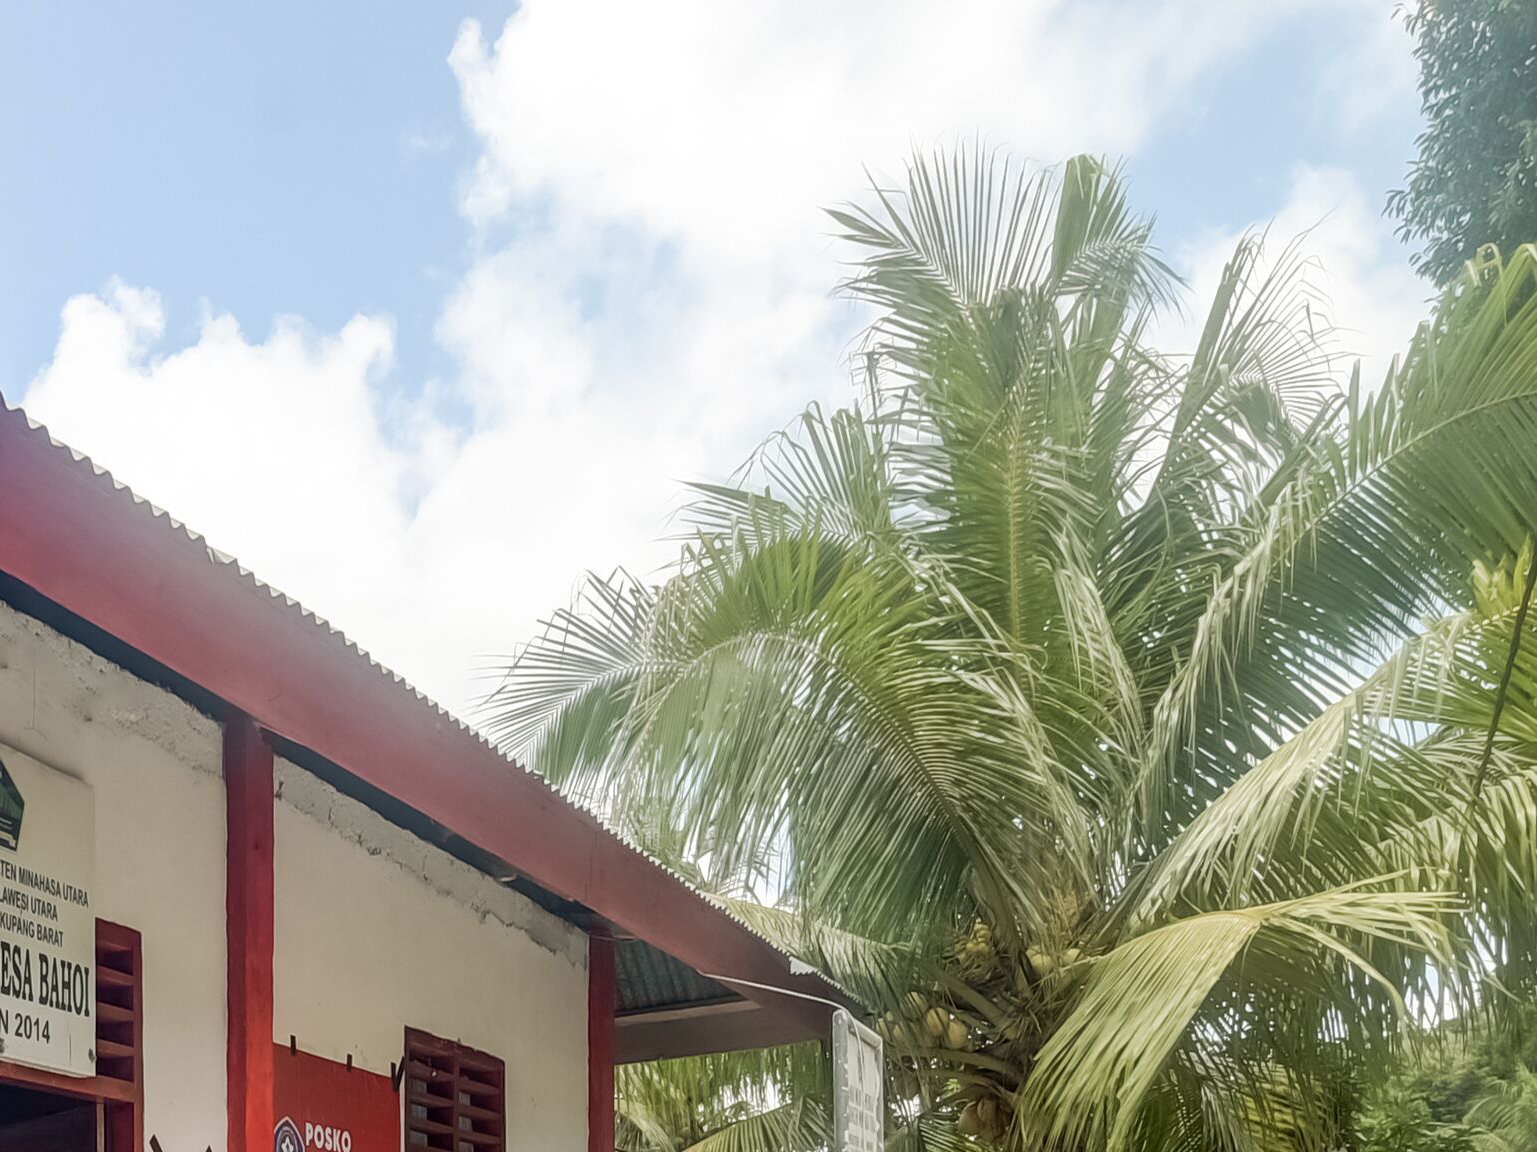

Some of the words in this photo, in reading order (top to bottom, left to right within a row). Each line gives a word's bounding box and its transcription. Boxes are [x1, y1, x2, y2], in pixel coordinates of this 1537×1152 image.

[18, 867, 62, 898] MINAHASA
[63, 883, 89, 908] UTARA
[30, 900, 58, 922] UTARA
[37, 925, 64, 948] BARAT
[38, 953, 90, 1017] BAHOI
[14, 1012, 51, 1044] 2014
